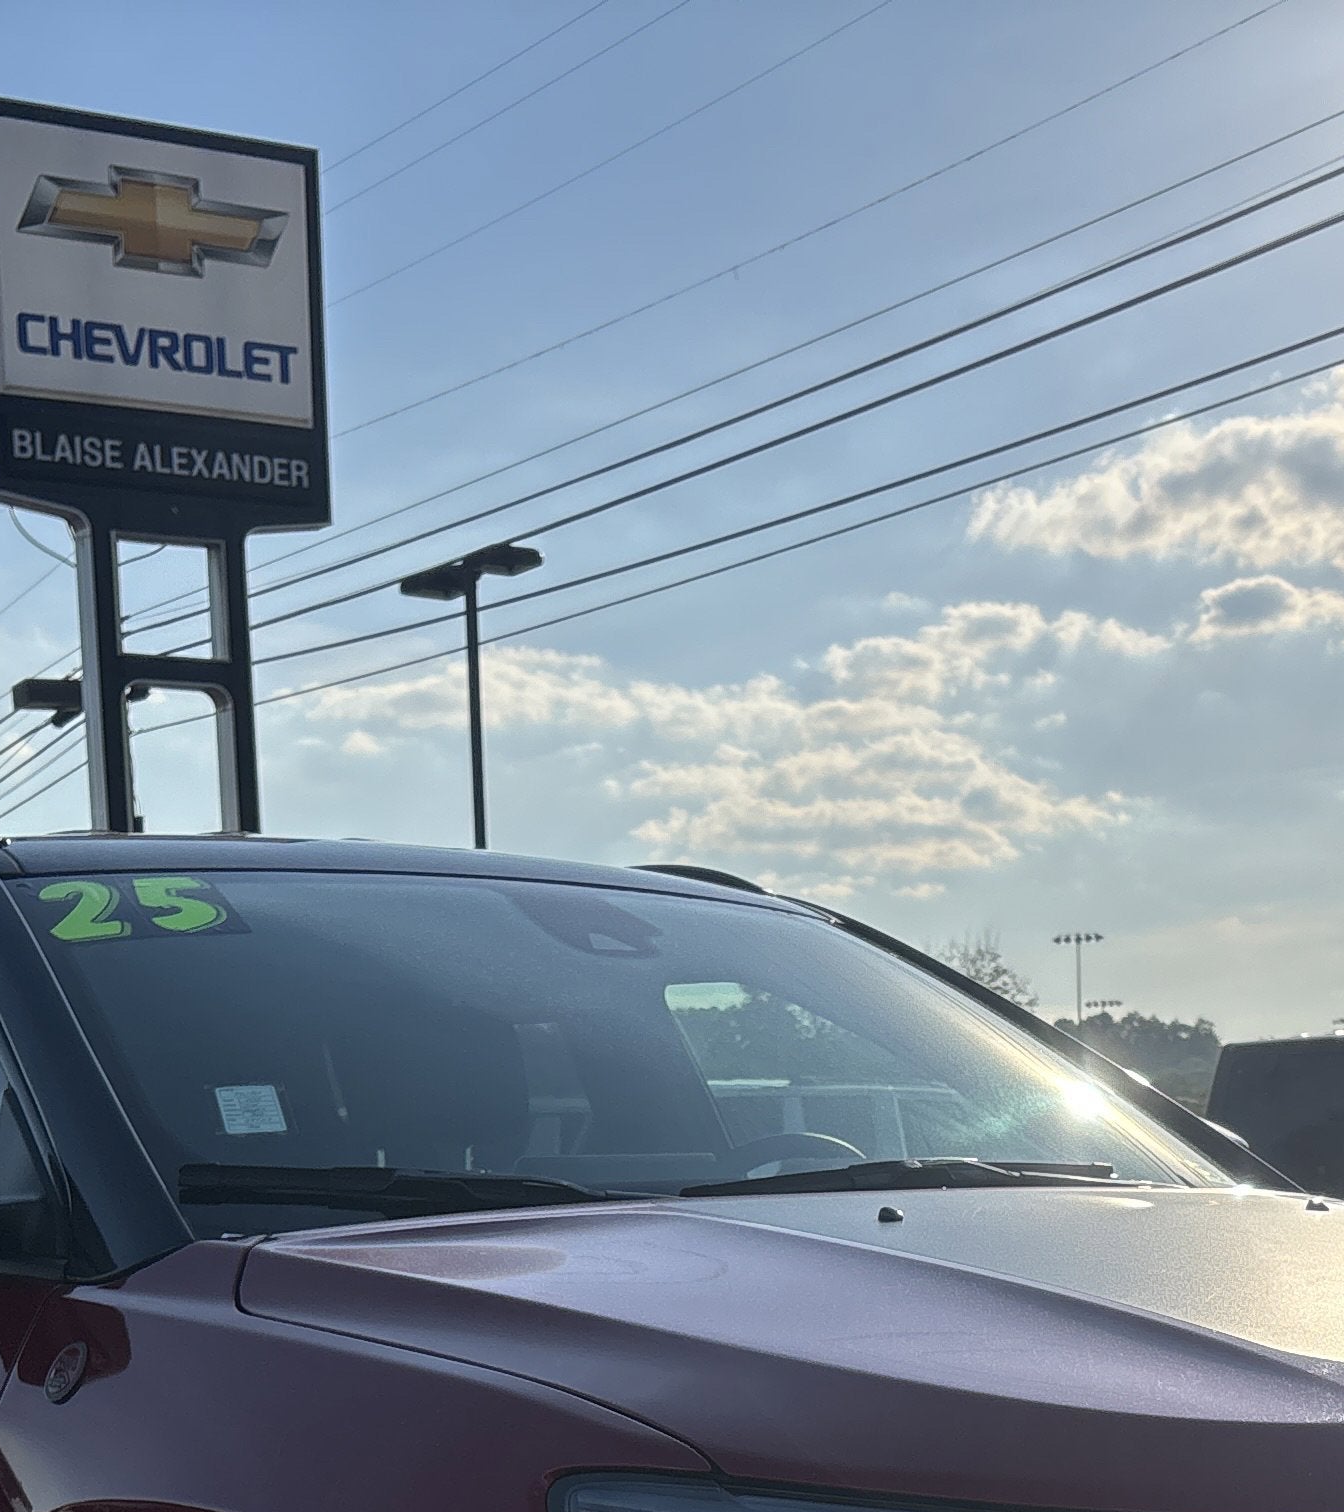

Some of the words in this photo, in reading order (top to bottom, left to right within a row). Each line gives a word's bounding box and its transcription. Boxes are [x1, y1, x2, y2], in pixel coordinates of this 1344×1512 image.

[17, 312, 298, 385] CHEVROLET
[12, 428, 124, 469] BLAISE
[134, 442, 310, 489] ALEXANDER
[38, 876, 227, 942] 25
